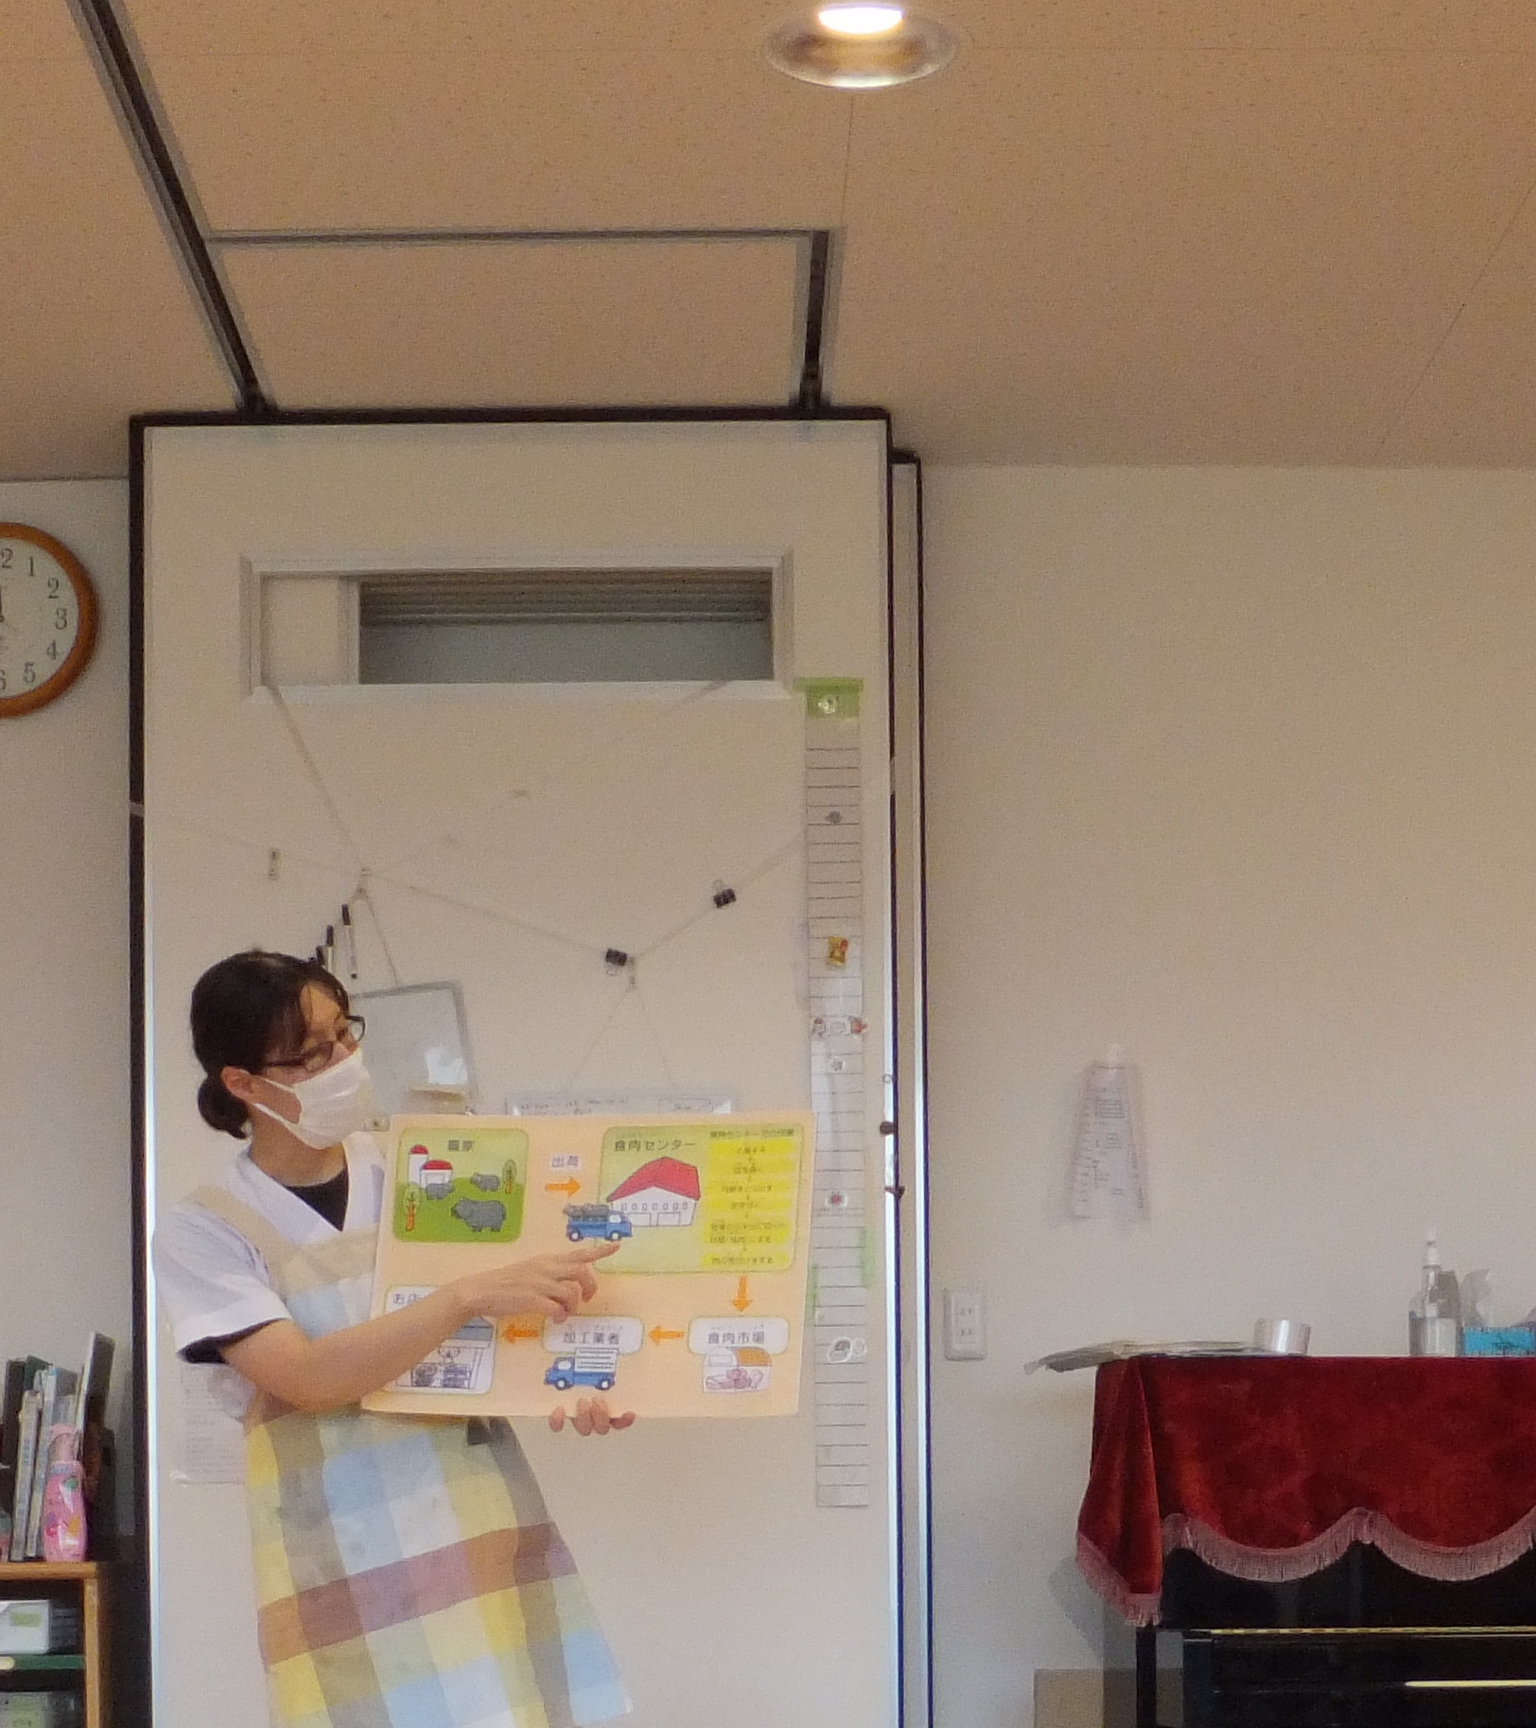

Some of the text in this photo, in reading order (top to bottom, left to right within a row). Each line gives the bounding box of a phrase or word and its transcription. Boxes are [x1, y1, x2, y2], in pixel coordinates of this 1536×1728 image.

[27, 557, 34, 577] 1
[47, 578, 60, 599] 2
[55, 608, 68, 630] 3
[46, 640, 58, 660] 4
[24, 663, 36, 683] 5
[614, 1140, 696, 1152] 食肉センター
[551, 1155, 579, 1168] 出荷
[563, 1332, 621, 1345] 加工業者
[708, 1331, 765, 1345] 食肉市場
